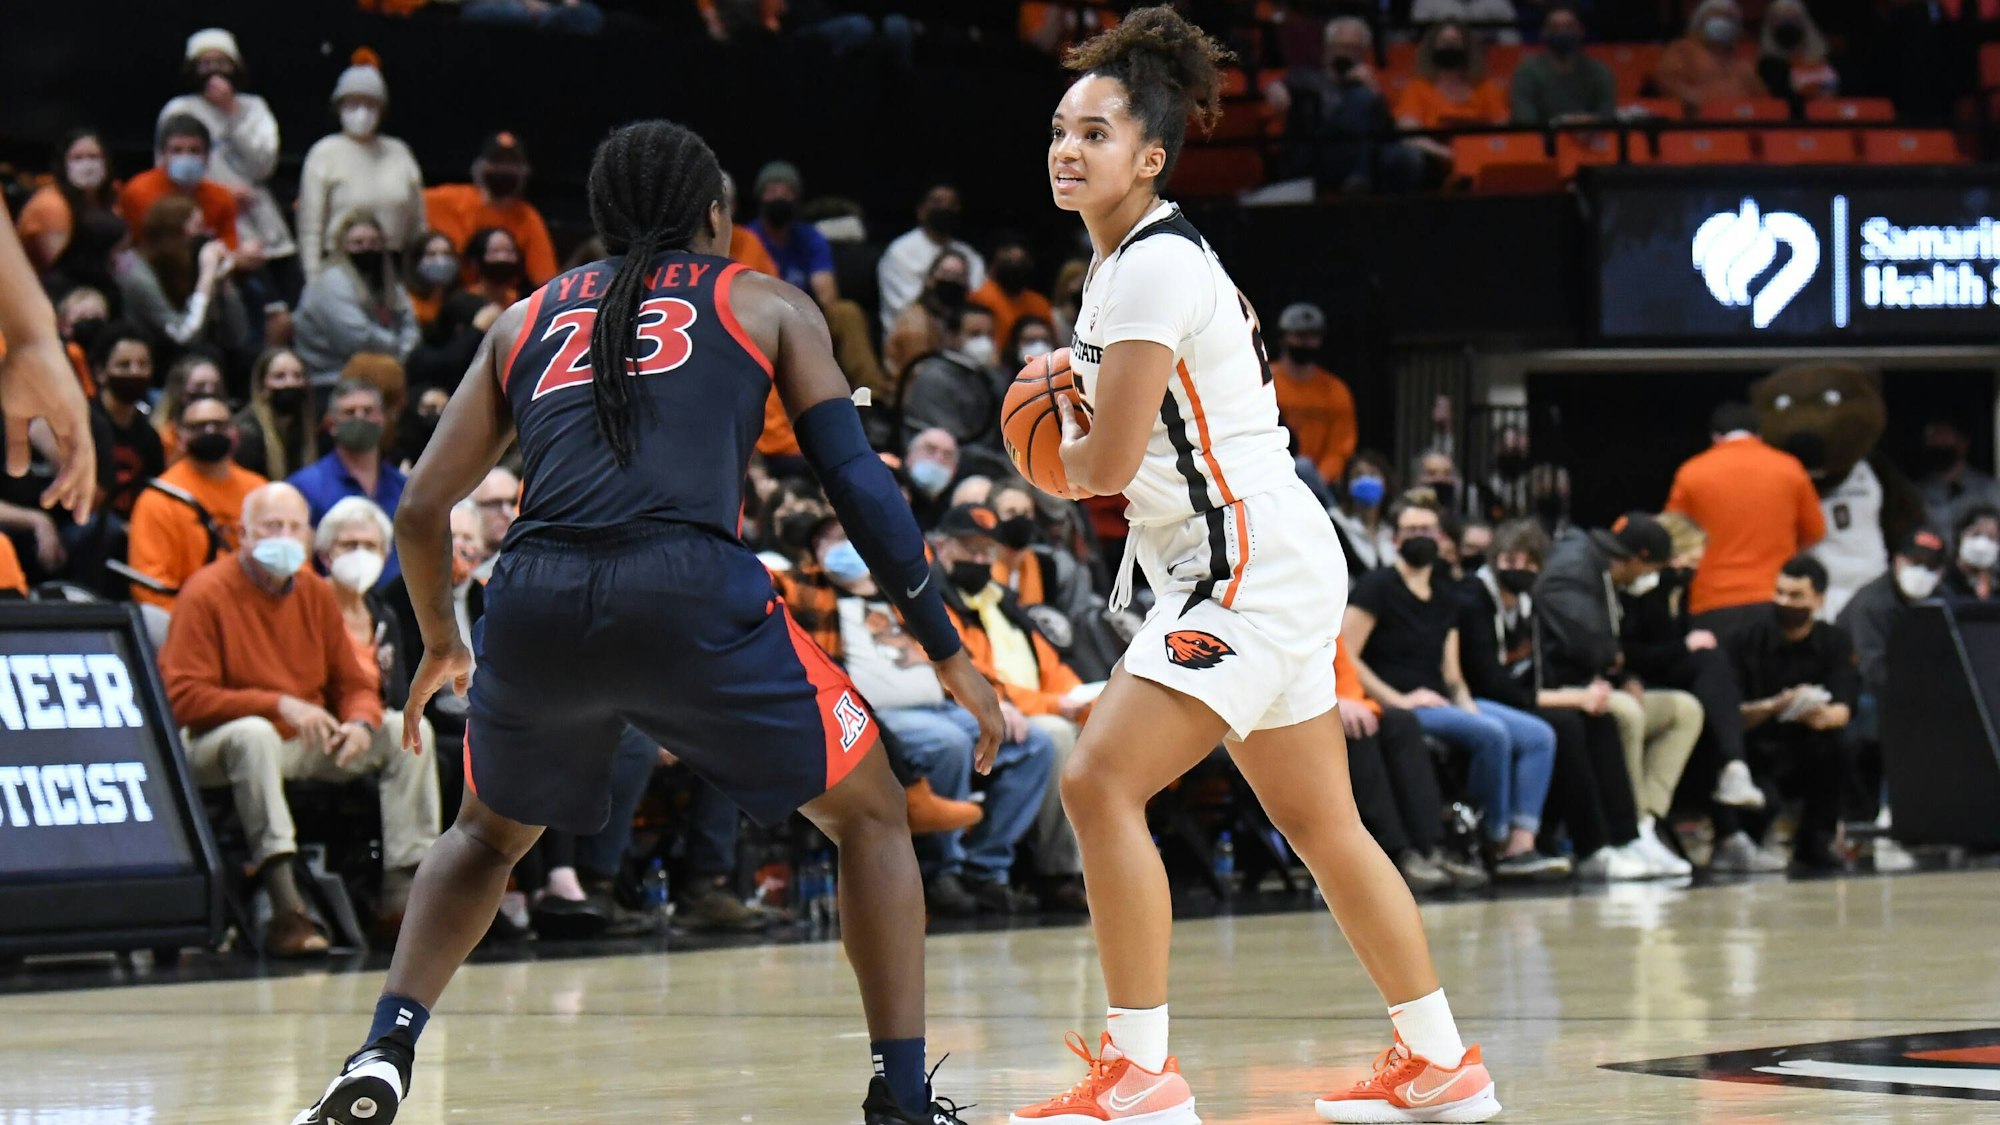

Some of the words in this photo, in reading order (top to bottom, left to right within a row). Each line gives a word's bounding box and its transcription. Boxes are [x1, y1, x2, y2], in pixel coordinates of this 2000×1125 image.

[558, 263, 710, 301] YENEY
[1862, 261, 1988, 308] Health
[531, 297, 697, 402] 23
[833, 690, 869, 753] A
[0, 762, 153, 827] TICIST
